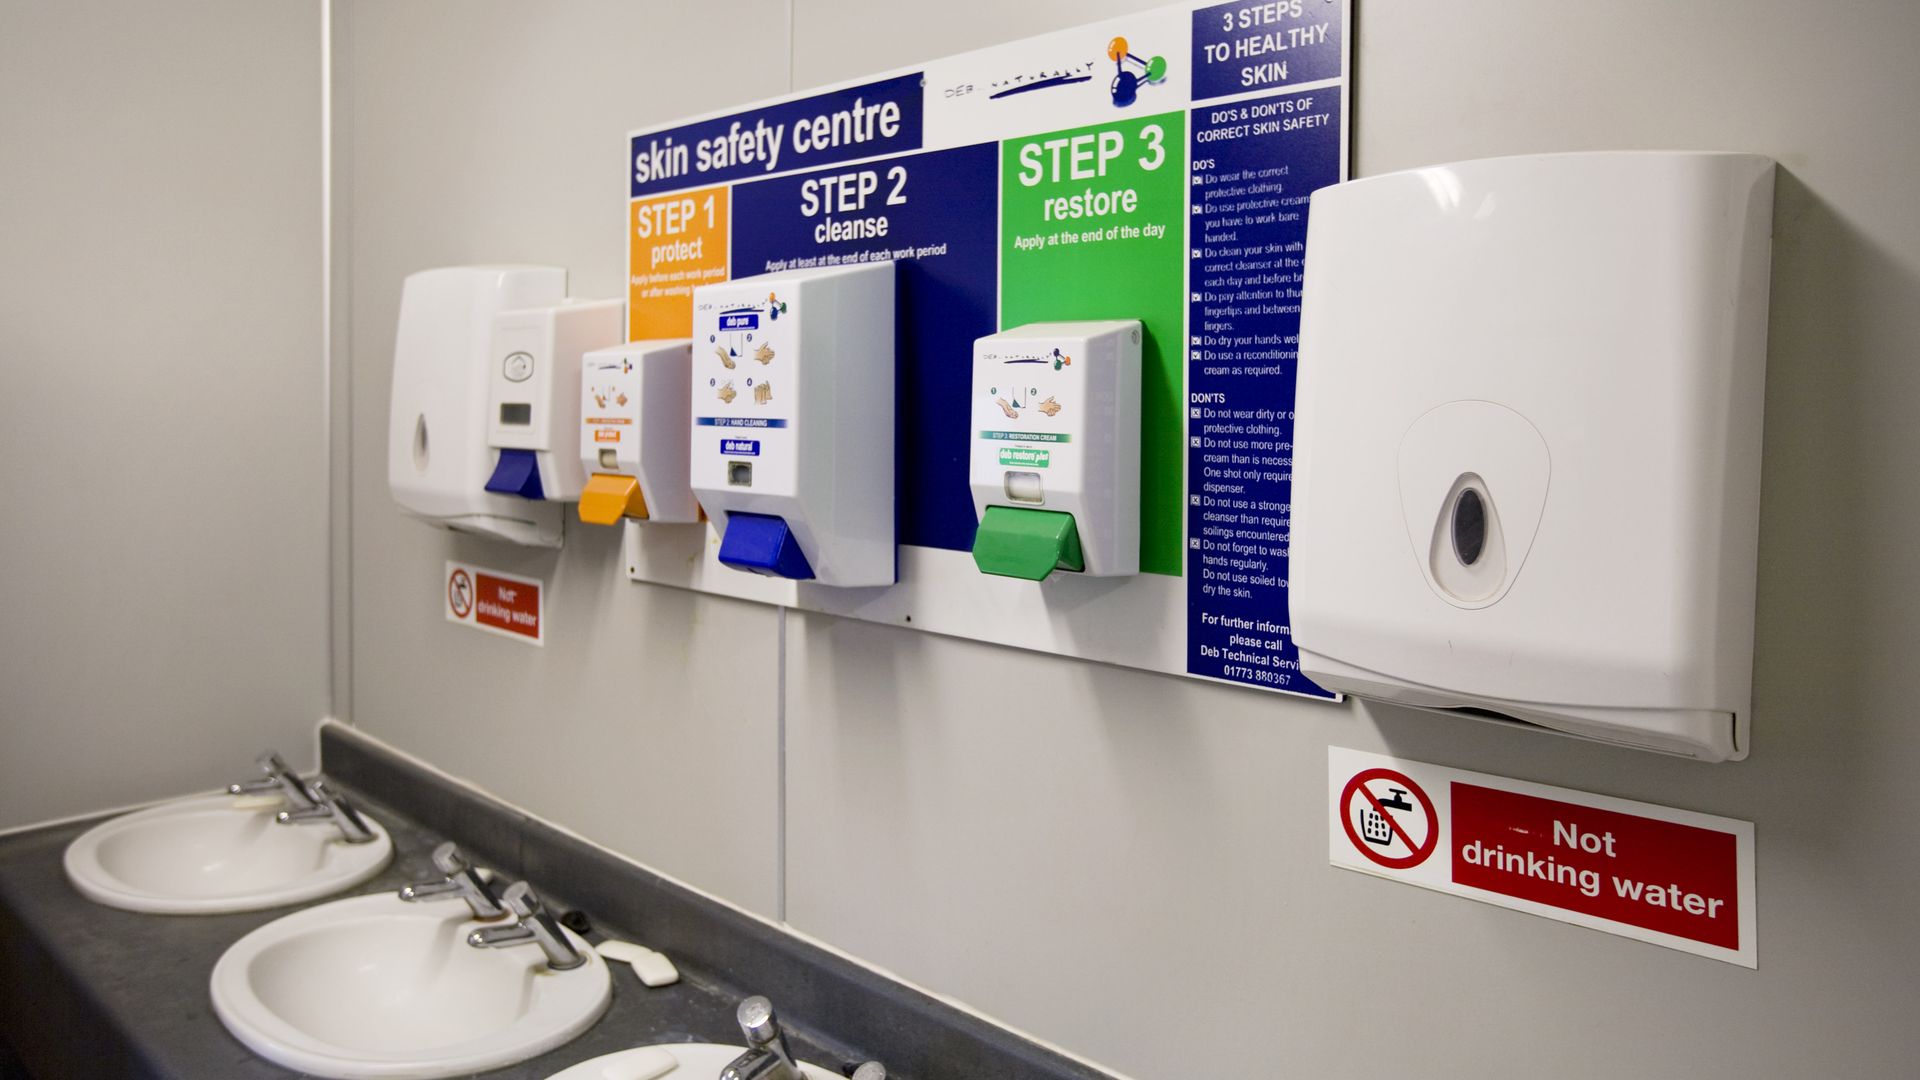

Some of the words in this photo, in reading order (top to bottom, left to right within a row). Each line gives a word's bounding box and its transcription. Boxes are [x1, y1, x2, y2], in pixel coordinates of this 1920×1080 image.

[1223, 12, 1233, 32] 3
[1239, 0, 1303, 29] STEPS
[1204, 42, 1230, 64] TO
[1235, 22, 1329, 59] HEALTHY
[1241, 61, 1288, 87] SKIN
[1212, 109, 1238, 124] DO'S
[1241, 108, 1249, 121] &
[1252, 101, 1294, 118] DON'TS
[1297, 97, 1314, 111] OF
[1197, 125, 1250, 143] CORRECT
[1253, 120, 1280, 135] SKIN
[1283, 113, 1330, 131] SAFETY
[635, 138, 689, 184] skin
[696, 118, 786, 172] safety
[792, 97, 901, 155] centre
[1018, 130, 1125, 187] STEP
[1138, 124, 1166, 171] 3
[1192, 158, 1215, 171] DO'S
[1205, 174, 1217, 185] Do
[1220, 171, 1240, 182] wear
[1243, 168, 1256, 180] the
[1258, 165, 1289, 179] correct
[801, 170, 878, 218] STEP
[886, 165, 907, 206] 2
[1205, 186, 1246, 201] protective
[1044, 187, 1138, 221] restore
[1205, 203, 1217, 215] Do
[1220, 202, 1235, 212] use
[1237, 196, 1279, 213] protective
[637, 199, 696, 239] STEP
[703, 194, 715, 229] 1
[1205, 220, 1220, 231] you
[1222, 216, 1243, 227] have
[1245, 215, 1254, 225] to
[1257, 213, 1275, 224] work
[1279, 210, 1299, 222] bare
[814, 215, 889, 245] cleanse
[1014, 235, 1045, 250] Apply
[1048, 233, 1059, 246] at
[1061, 231, 1079, 245] the
[1081, 228, 1103, 242] end
[1106, 226, 1118, 240] of
[1120, 225, 1140, 239] the
[1143, 223, 1166, 239] day
[652, 236, 703, 269] protect
[766, 258, 788, 272] Apply
[798, 255, 816, 268] least
[818, 255, 825, 266] at
[827, 253, 841, 265] the
[842, 251, 858, 264] end
[860, 249, 869, 262] of
[870, 248, 891, 262] each
[893, 247, 914, 259] work
[916, 243, 947, 260] period
[1205, 247, 1217, 258] Do
[1219, 244, 1241, 256] clean
[1244, 246, 1262, 257] your
[1265, 243, 1283, 254] skin
[1285, 240, 1303, 252] with
[1205, 260, 1233, 272] correct
[1235, 257, 1271, 270] cleanser
[1274, 256, 1282, 267] at
[1285, 255, 1299, 267] the
[1205, 276, 1225, 287] each
[1227, 275, 1242, 287] day
[1244, 274, 1261, 285] and
[1263, 271, 1291, 284] before
[1204, 290, 1217, 302] Do
[1219, 291, 1234, 303] pay
[1236, 289, 1273, 301] attention
[1275, 287, 1284, 299] to
[1204, 304, 1242, 318] fingertips
[1244, 304, 1260, 315] and
[1204, 335, 1217, 346] Do
[1218, 335, 1235, 347] dry
[1235, 335, 1253, 348] your
[1255, 333, 1281, 345] hands
[1204, 349, 1217, 361] Do
[1218, 350, 1233, 361] use
[1235, 351, 1241, 361] a
[1204, 366, 1230, 376] cream
[1232, 366, 1242, 376] as
[1191, 393, 1225, 404] DON'TS
[1203, 408, 1216, 419] Do
[1218, 408, 1231, 420] not
[1233, 410, 1254, 421] wear
[1256, 408, 1275, 422] dirty
[1277, 410, 1286, 421] or
[1203, 423, 1245, 436] protective
[1203, 437, 1216, 448] Do
[1218, 438, 1231, 449] not
[1233, 440, 1248, 450] use
[1251, 441, 1273, 451] more
[1203, 454, 1230, 464] cream
[1231, 452, 1250, 464] than
[1252, 453, 1259, 465] is
[1203, 467, 1221, 478] One
[1223, 468, 1242, 480] shot
[1244, 468, 1261, 482] only
[1203, 495, 1216, 507] Do
[1218, 497, 1231, 508] not
[1232, 499, 1248, 510] use
[1250, 500, 1256, 510] a
[1203, 511, 1239, 523] cleanser
[1240, 513, 1259, 525] than
[1203, 526, 1234, 540] soilings
[1203, 540, 1216, 551] Do
[1217, 540, 1230, 552] not
[1232, 541, 1257, 556] forget
[1259, 544, 1267, 556] to
[1202, 554, 1228, 567] hands
[1203, 568, 1216, 580] Do
[1217, 570, 1231, 582] not
[1232, 573, 1248, 583] use
[1250, 573, 1275, 587] soiled
[498, 586, 517, 603] Not
[1202, 583, 1216, 597] dry
[1218, 584, 1231, 597] the
[478, 600, 511, 624] drinking
[511, 610, 537, 628] water
[1201, 612, 1219, 626] For
[1221, 615, 1254, 631] further
[1230, 634, 1262, 649] please
[1265, 639, 1283, 651] call
[1200, 645, 1220, 659] Deb
[1222, 648, 1270, 666] Technical
[1224, 664, 1254, 681] 01773
[1256, 671, 1291, 686] 880367
[1553, 820, 1617, 858] Not
[1462, 840, 1602, 897] drinking
[1612, 875, 1724, 919] water
